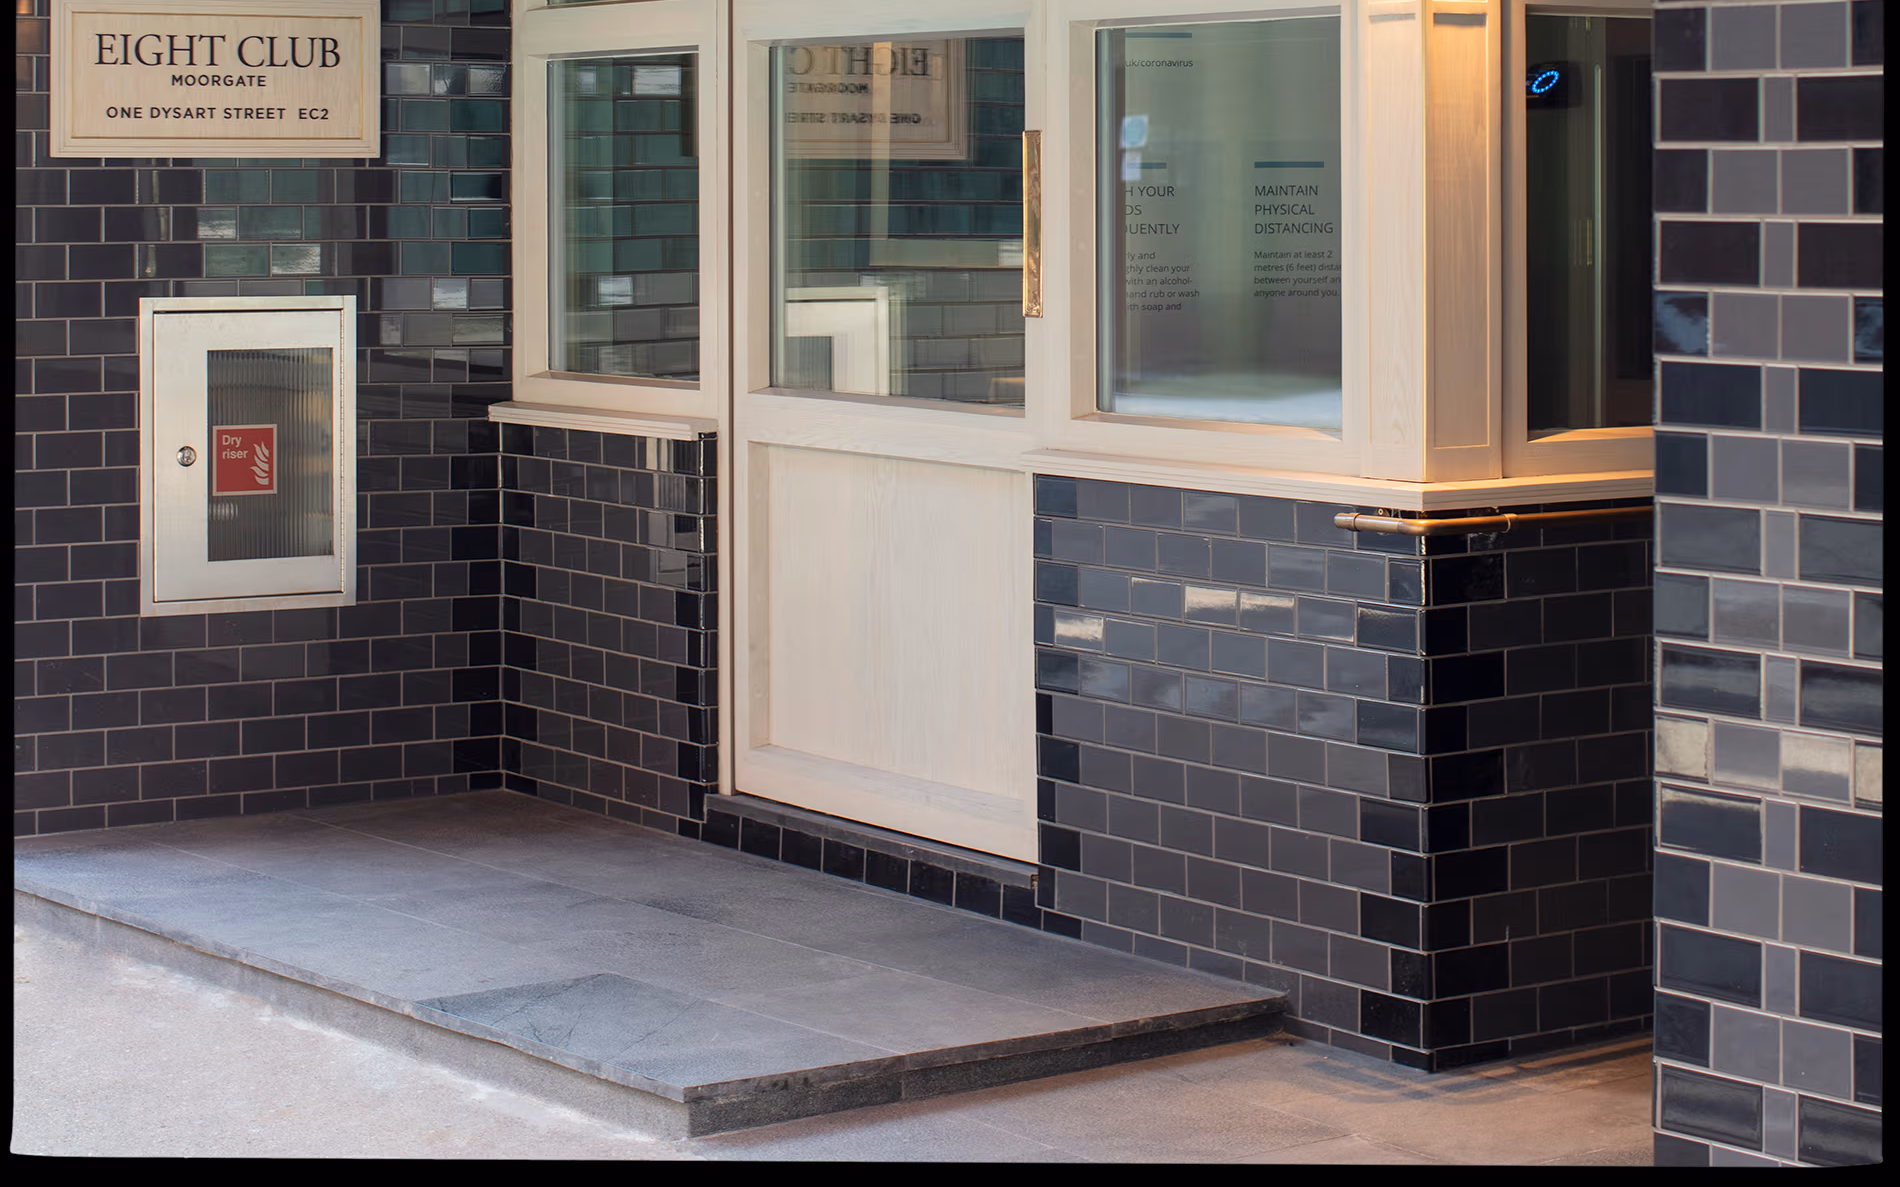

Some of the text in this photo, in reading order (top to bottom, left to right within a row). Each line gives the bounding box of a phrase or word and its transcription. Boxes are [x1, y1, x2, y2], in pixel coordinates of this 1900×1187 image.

[94, 33, 341, 68] EIGHT CLUB
[171, 74, 267, 87] MOORGATE
[106, 106, 329, 120] ONE DYSART STREET EC2
[1138, 185, 1175, 197] YOUR
[1255, 185, 1318, 196] MAINTAIN
[1255, 203, 1315, 215] PHYSICAL
[1126, 223, 1180, 235] UENTLY
[1255, 222, 1334, 234] DISTANCING
[1137, 252, 1156, 260] and
[1254, 251, 1292, 259] Maintain
[1304, 251, 1325, 259] least
[1146, 264, 1169, 273] clean
[1171, 266, 1191, 274] your
[1254, 264, 1284, 272] metres
[1254, 275, 1341, 286] between yourself an
[1149, 290, 1165, 298] rub
[1178, 288, 1200, 298] wash
[1254, 290, 1286, 299] anyone
[1287, 288, 1319, 297] around
[1141, 302, 1164, 312] soap
[1165, 301, 1182, 310] and
[222, 434, 242, 448] Dry
[222, 448, 248, 459] riser
